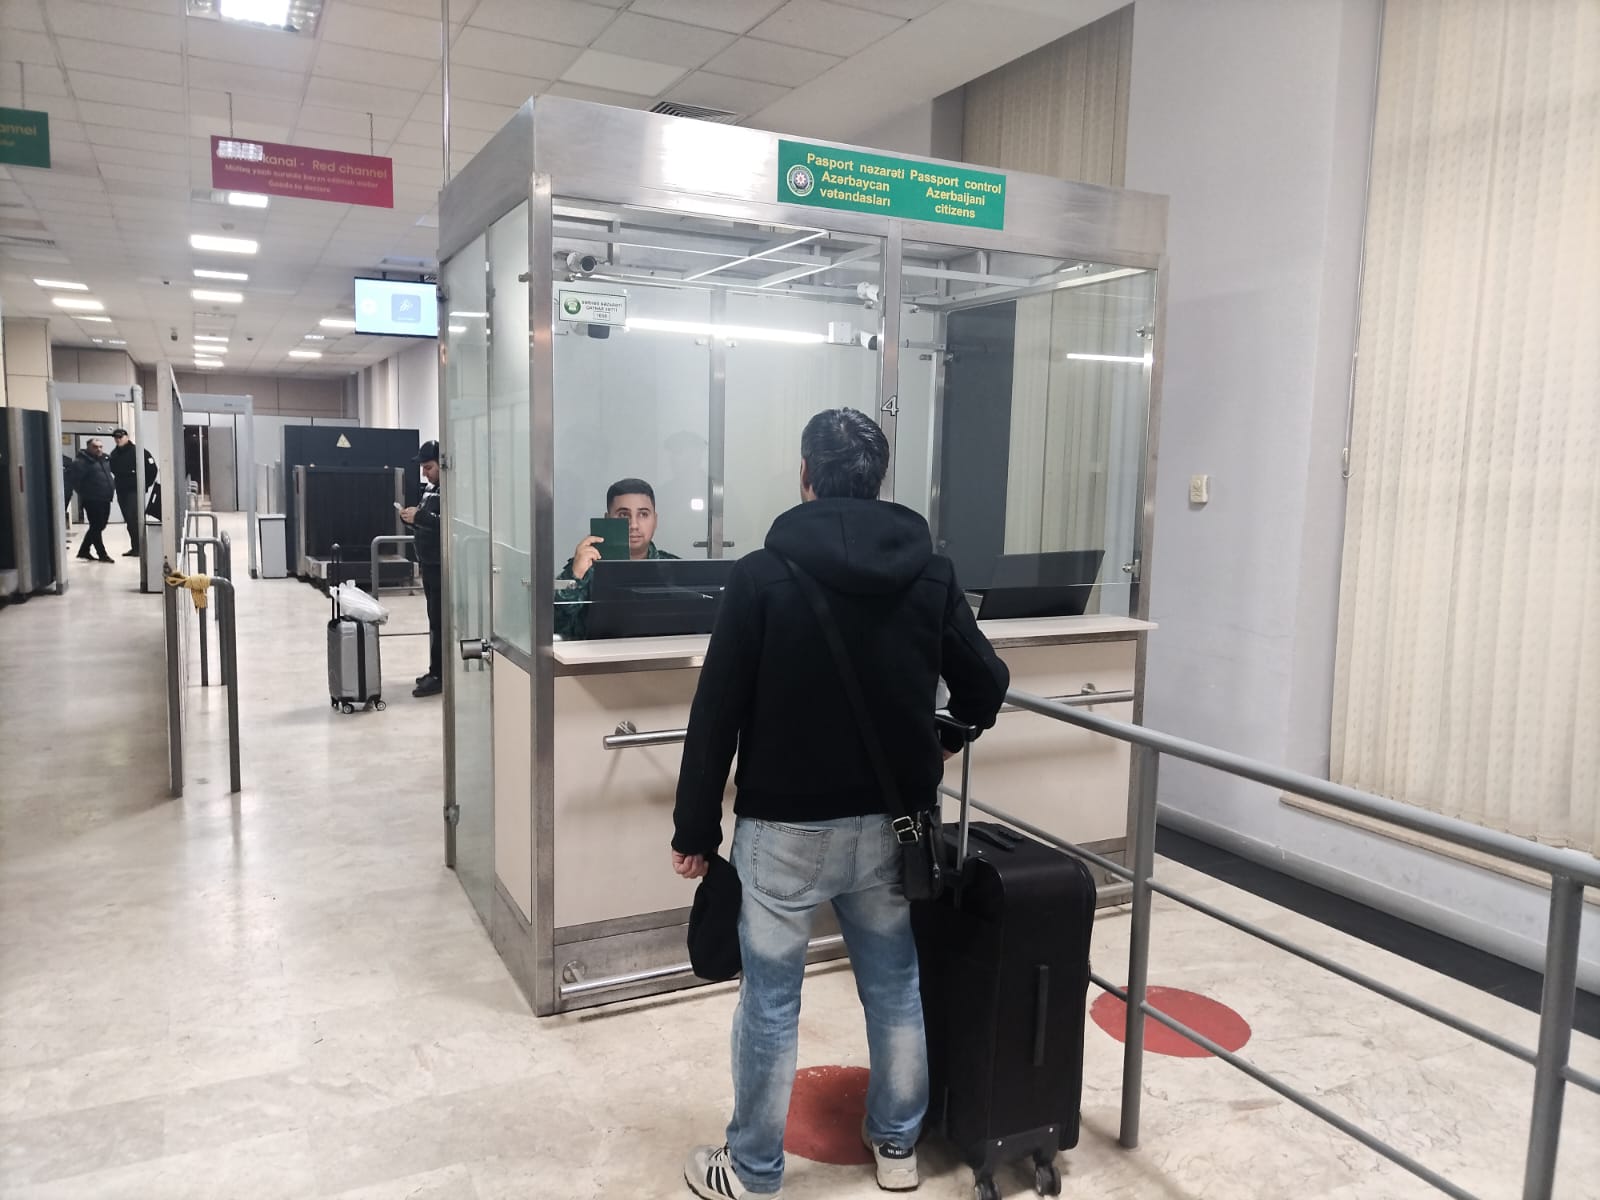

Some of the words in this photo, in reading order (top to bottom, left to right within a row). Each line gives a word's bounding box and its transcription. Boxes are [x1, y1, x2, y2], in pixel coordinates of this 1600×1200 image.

[262, 153, 297, 167] kanal
[312, 160, 336, 172] Red
[339, 163, 387, 179] channel
[806, 153, 854, 171] Pasport
[859, 163, 905, 179] nəzarəti
[821, 171, 890, 192] Azərbaycan
[909, 169, 959, 188] Passport
[964, 180, 1002, 194] control
[926, 186, 986, 206] Azerbaijani
[934, 203, 976, 218] citizens
[881, 395, 899, 416] 4
